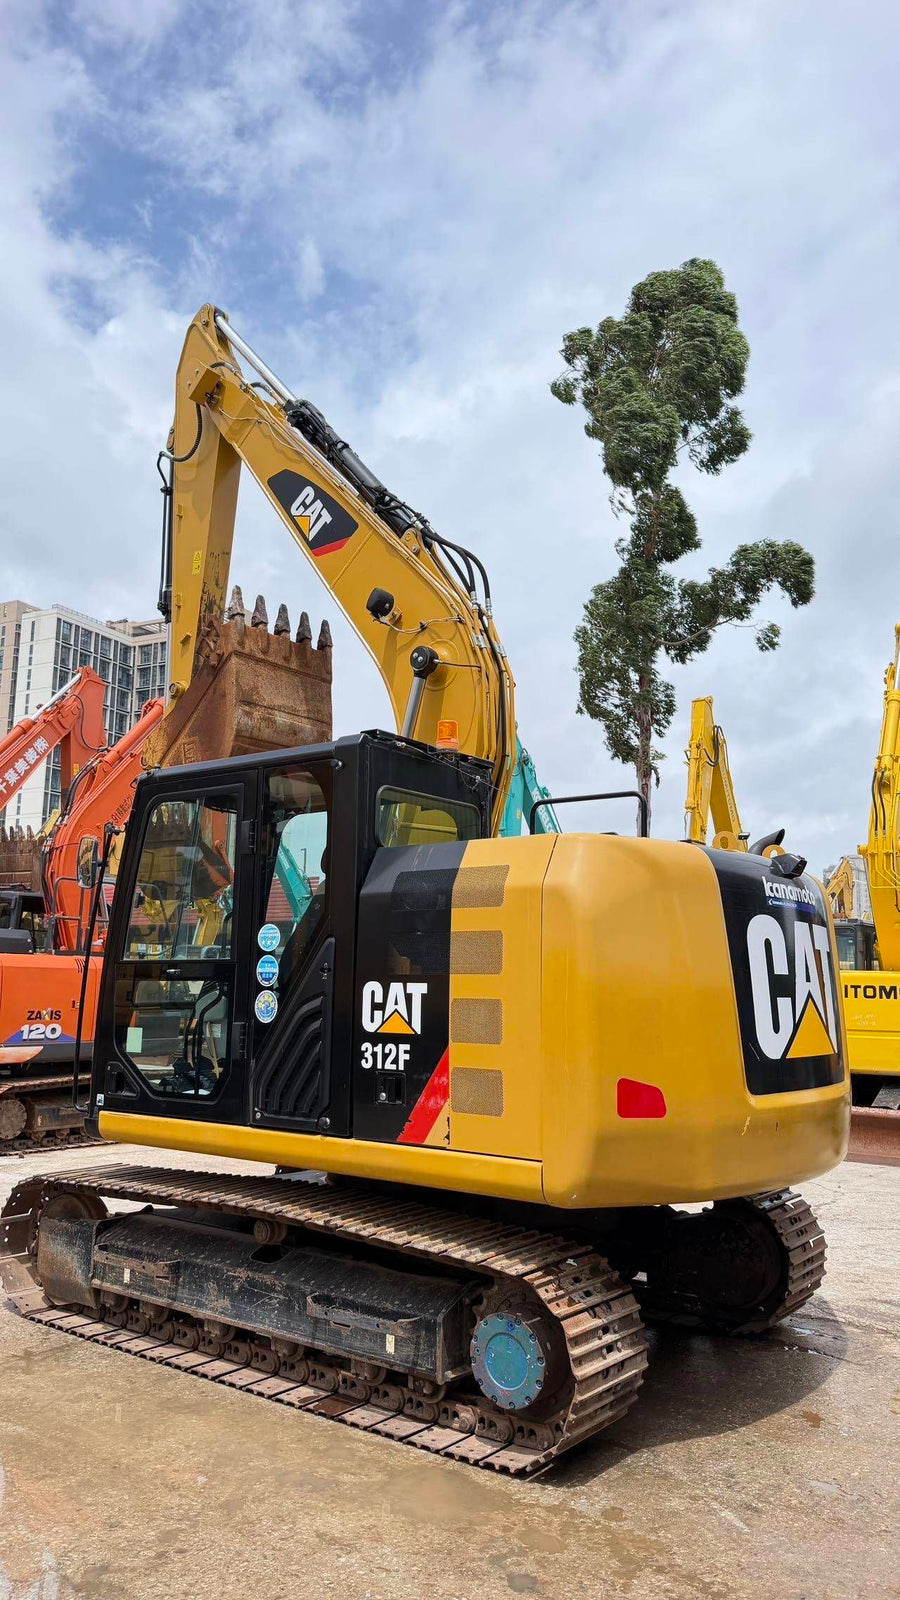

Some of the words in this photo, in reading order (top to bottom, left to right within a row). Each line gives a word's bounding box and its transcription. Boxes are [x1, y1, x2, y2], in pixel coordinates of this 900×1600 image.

[290, 486, 333, 541] CAT
[747, 914, 838, 1060] CAT
[844, 984, 900, 1000] ITOM
[27, 1008, 62, 1021] ZAXIS
[362, 981, 428, 1035] CAT
[20, 1023, 62, 1040] 120
[361, 1042, 411, 1071] 312F
